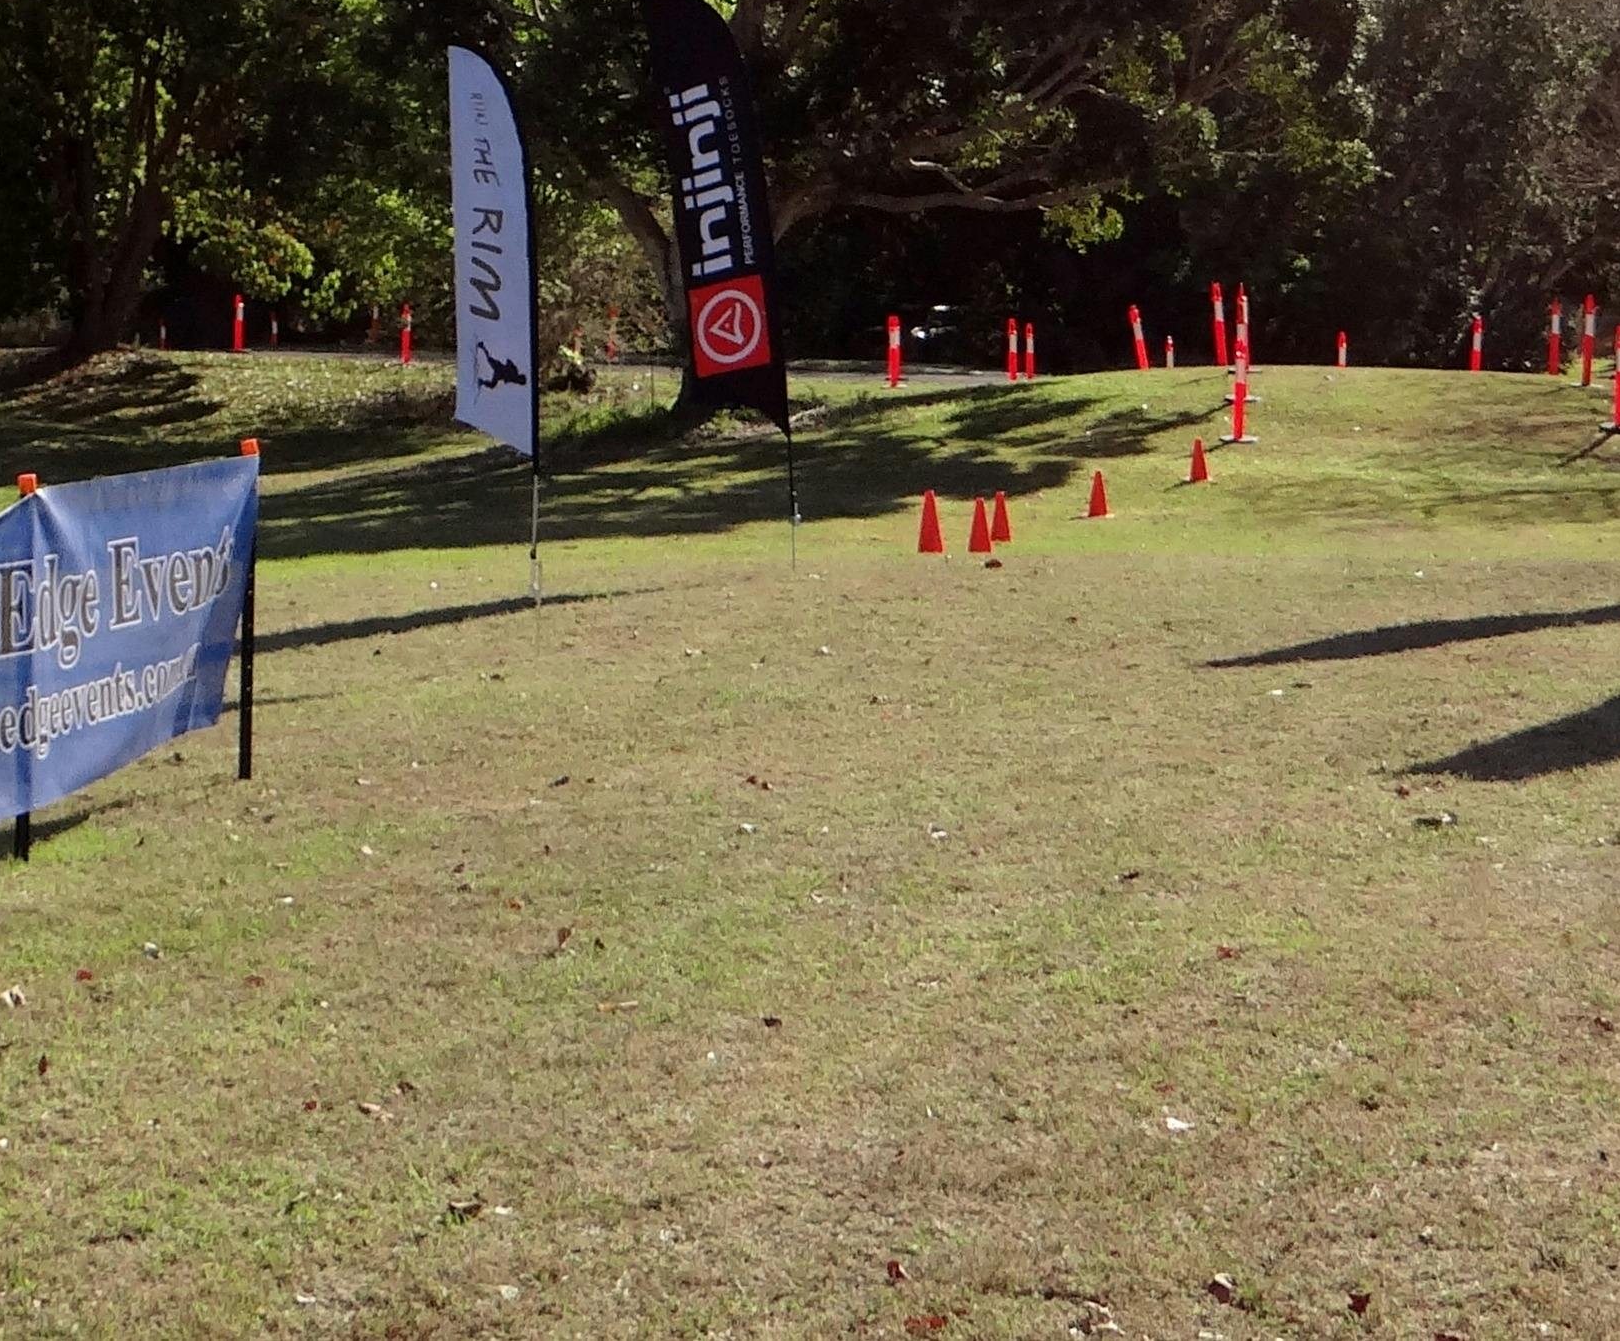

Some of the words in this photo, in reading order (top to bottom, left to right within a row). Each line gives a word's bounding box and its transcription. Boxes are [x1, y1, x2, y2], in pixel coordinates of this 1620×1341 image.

[473, 137, 501, 187] THE
[718, 75, 743, 165] TOESOCKS
[669, 83, 734, 277] injinji
[734, 170, 756, 265] PERFORMANCE
[469, 207, 503, 321] RIM
